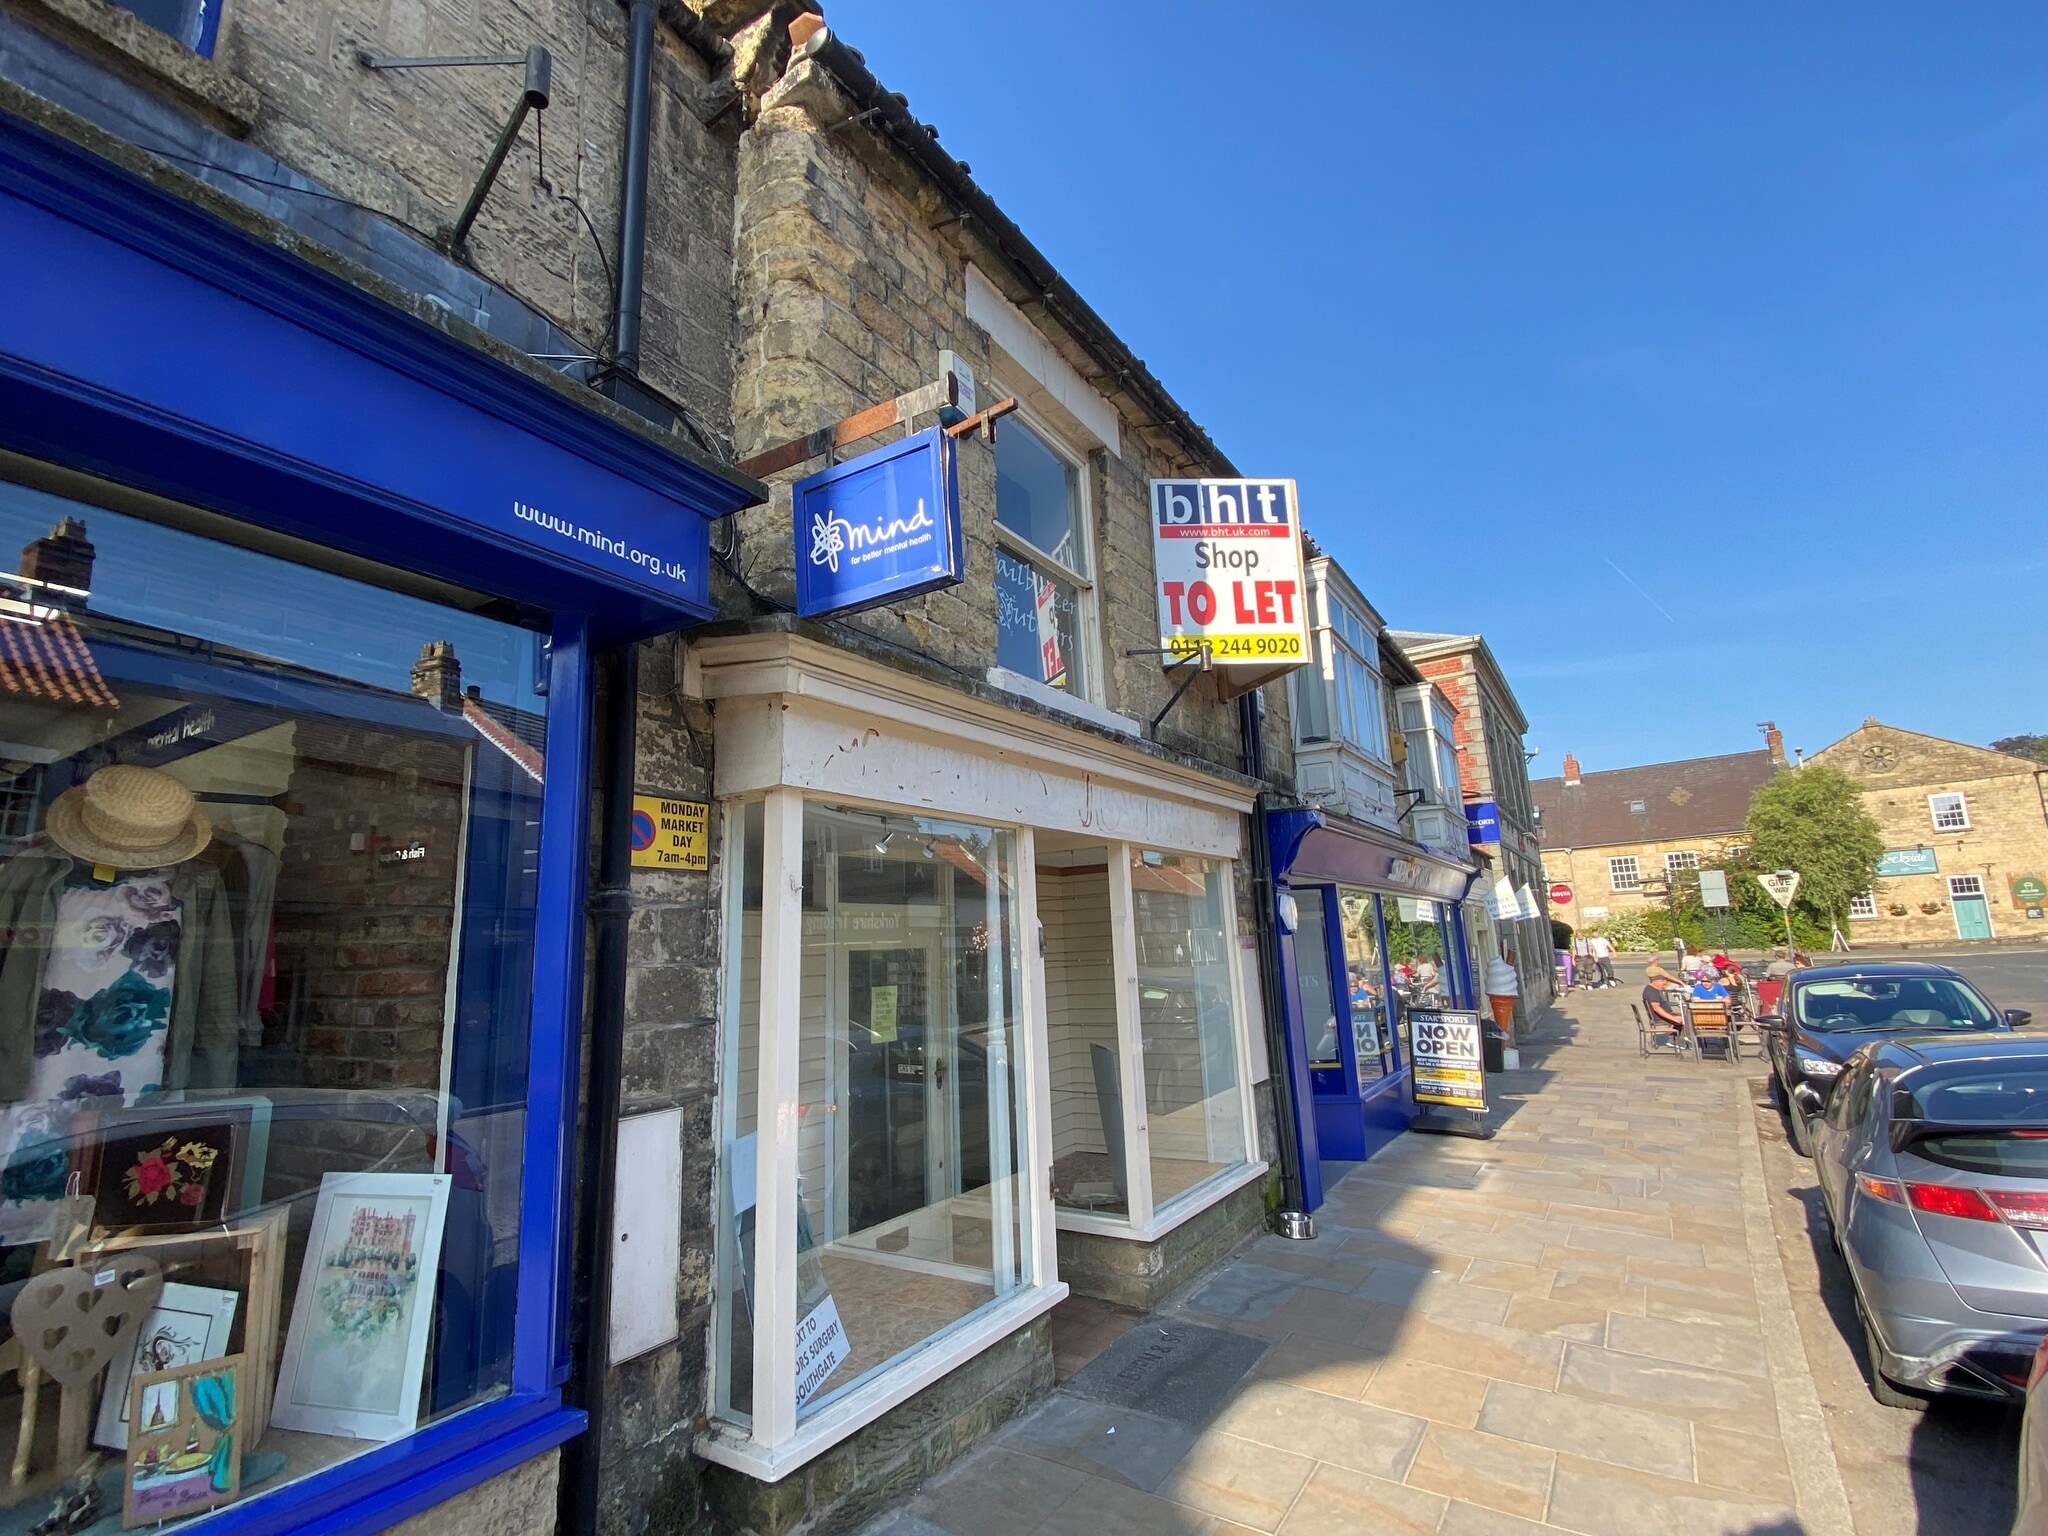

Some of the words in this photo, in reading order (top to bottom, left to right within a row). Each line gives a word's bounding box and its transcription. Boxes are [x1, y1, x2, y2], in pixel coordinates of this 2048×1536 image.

[1164, 485, 1279, 524] bht
[842, 498, 933, 551] mind
[1179, 526, 1271, 538] www.bht.uk.com
[513, 501, 686, 583] www.mind.org.uk
[850, 555, 861, 566] for
[862, 550, 882, 562] better
[884, 542, 908, 554] mental
[909, 533, 932, 546] health
[1195, 541, 1259, 576] Shop
[1163, 580, 1217, 626] TO
[1232, 580, 1296, 624] LET
[1219, 639, 1252, 655] 244
[1256, 638, 1300, 655] 9020
[661, 801, 705, 818] MONDAY
[661, 818, 704, 833] MARKET
[673, 835, 692, 848] DAY
[657, 849, 706, 866] 7am-4pm
[1768, 878, 1792, 887] GIVE
[1773, 886, 1790, 894] WAY
[1418, 1024, 1471, 1041] NOW
[1416, 1040, 1475, 1057] OPEN
[807, 1317, 817, 1335] TO
[809, 1319, 840, 1360] SURGERY
